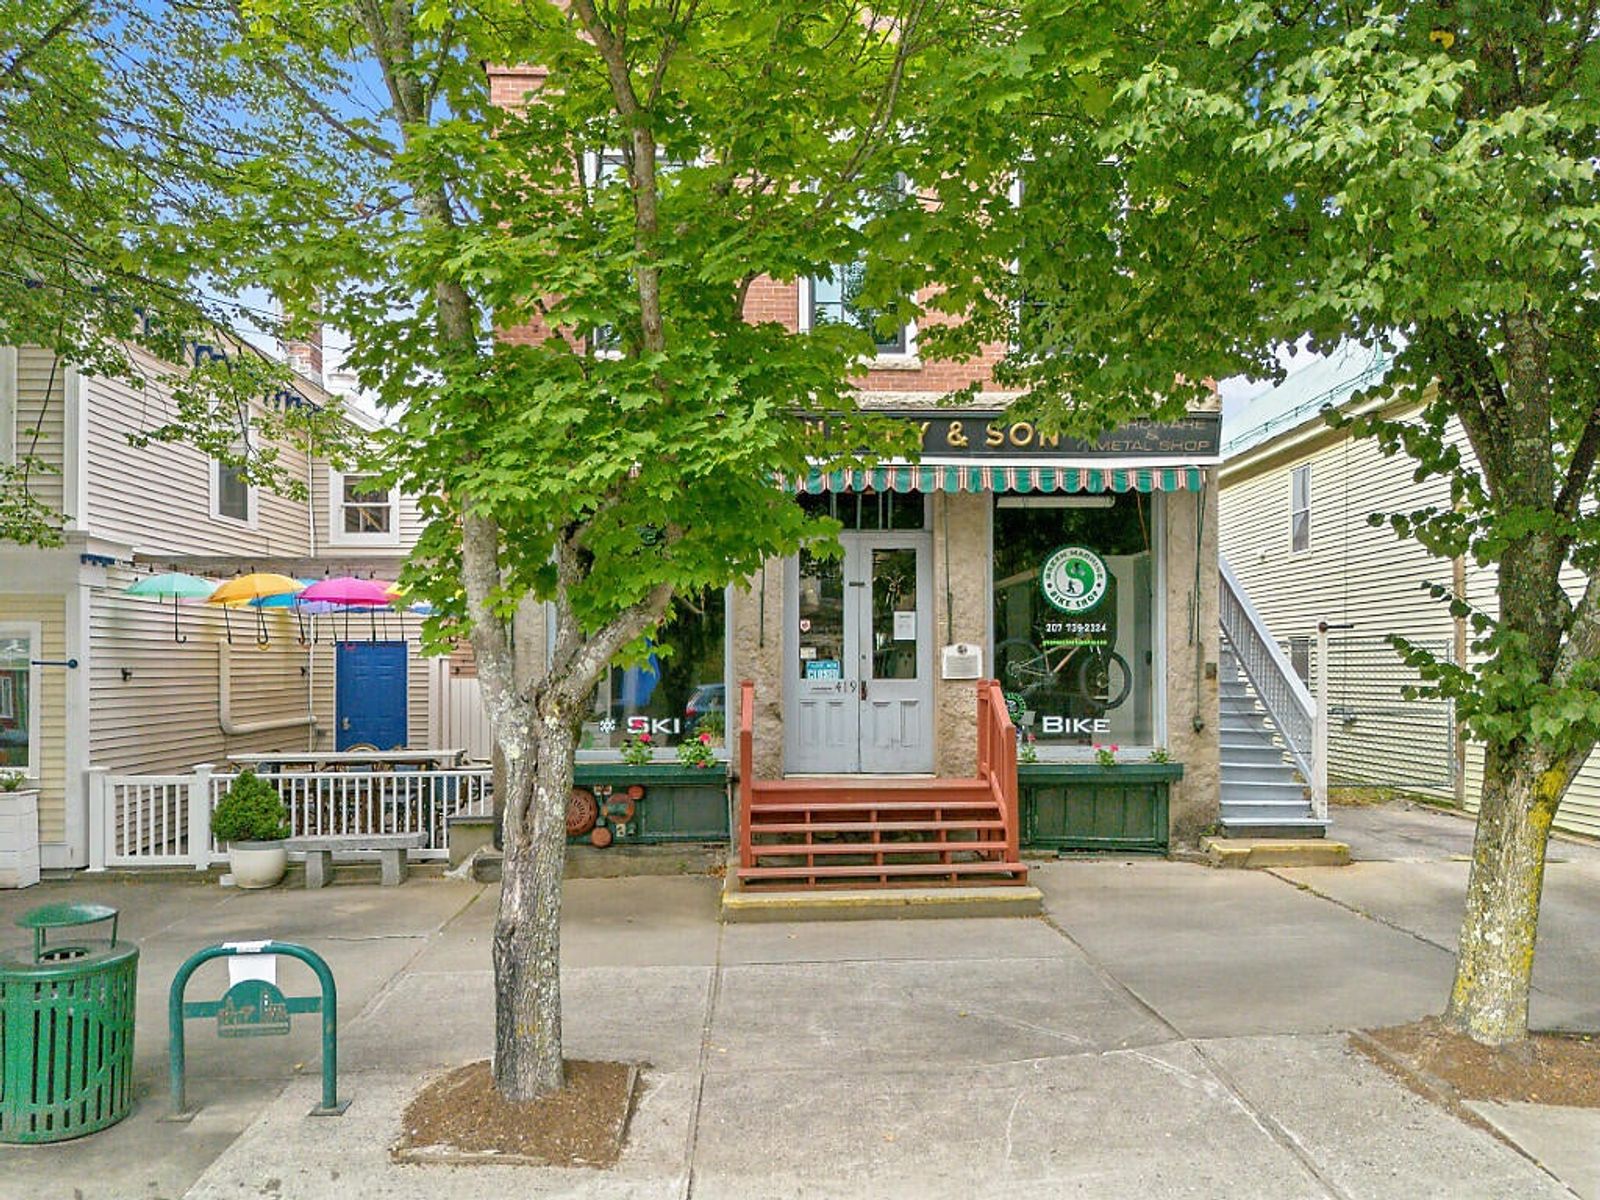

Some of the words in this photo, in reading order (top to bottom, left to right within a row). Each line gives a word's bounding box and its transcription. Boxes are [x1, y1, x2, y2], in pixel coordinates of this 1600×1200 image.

[947, 421, 968, 447] &
[985, 421, 1059, 447] SON
[1096, 440, 1151, 451] METAL
[1159, 440, 1211, 451] SHOP
[1050, 590, 1071, 607] BIKE
[1076, 590, 1098, 607] SHOP
[1045, 623, 1062, 632] 207
[626, 716, 680, 734] SKI
[1042, 716, 1111, 733] BIKE
